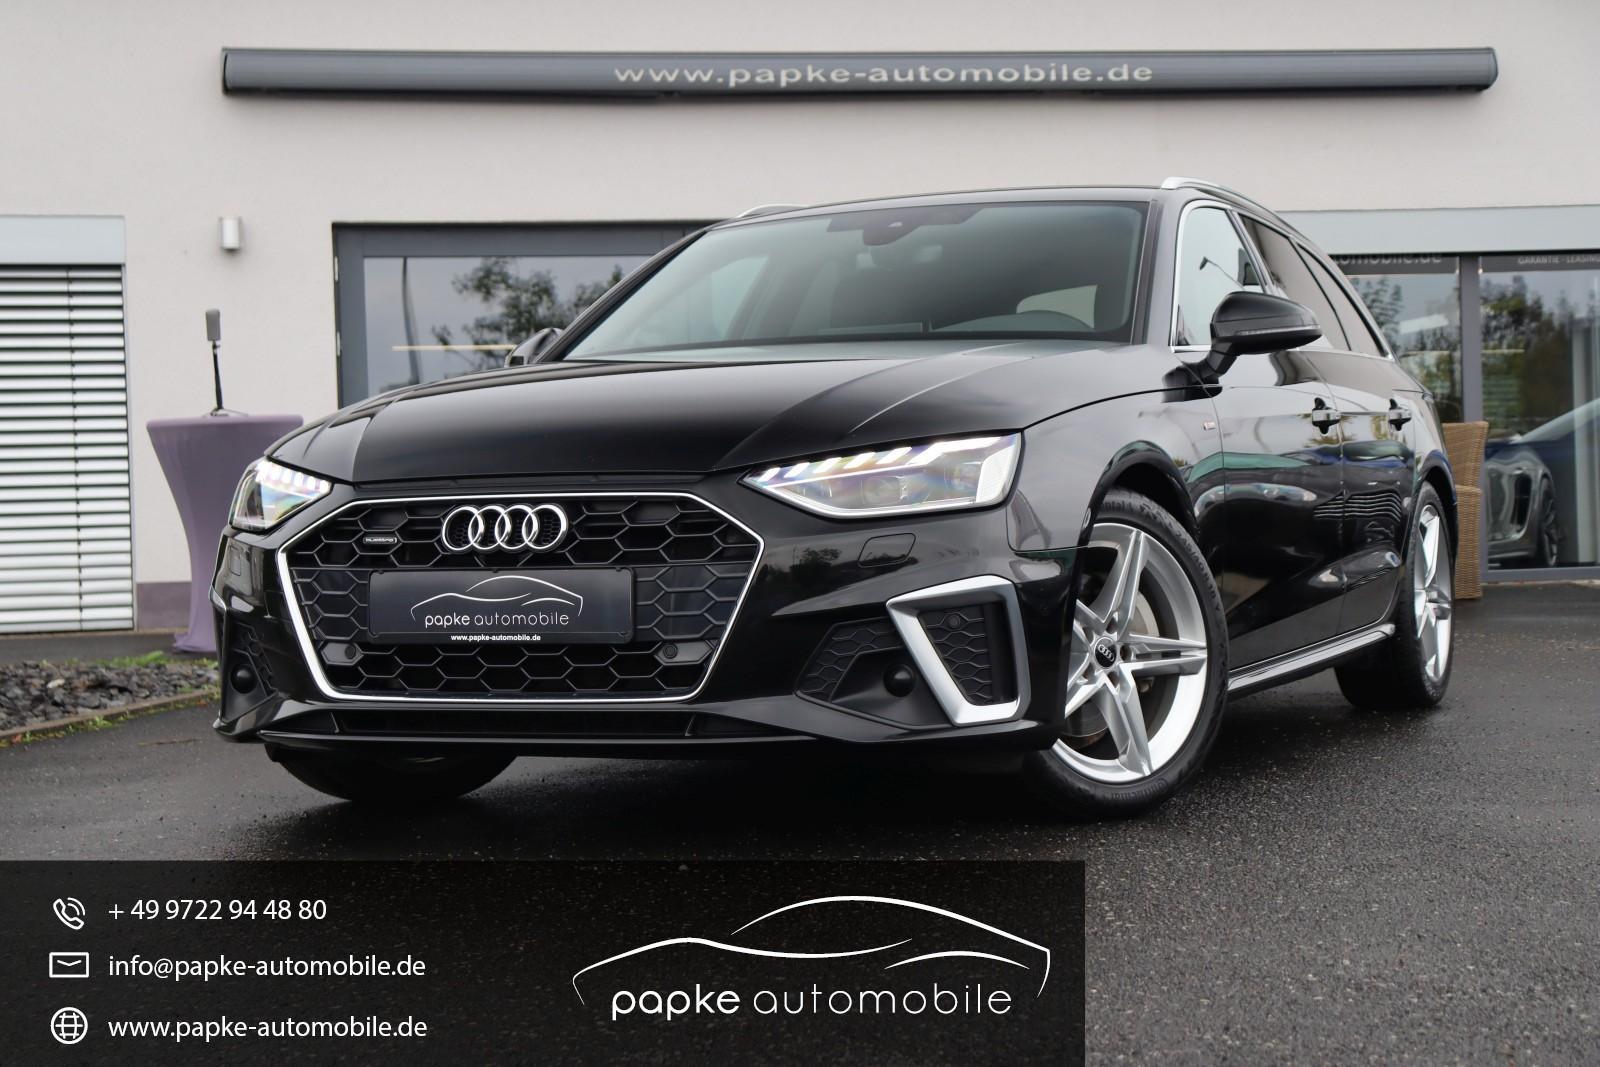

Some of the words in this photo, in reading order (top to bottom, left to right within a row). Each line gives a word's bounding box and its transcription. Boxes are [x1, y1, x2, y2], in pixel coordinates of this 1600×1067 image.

[614, 63, 1153, 87] www.papke-automobile.de
[425, 612, 470, 628] papke
[474, 612, 569, 626] automobile
[451, 634, 541, 642] www.papke-automobile.de
